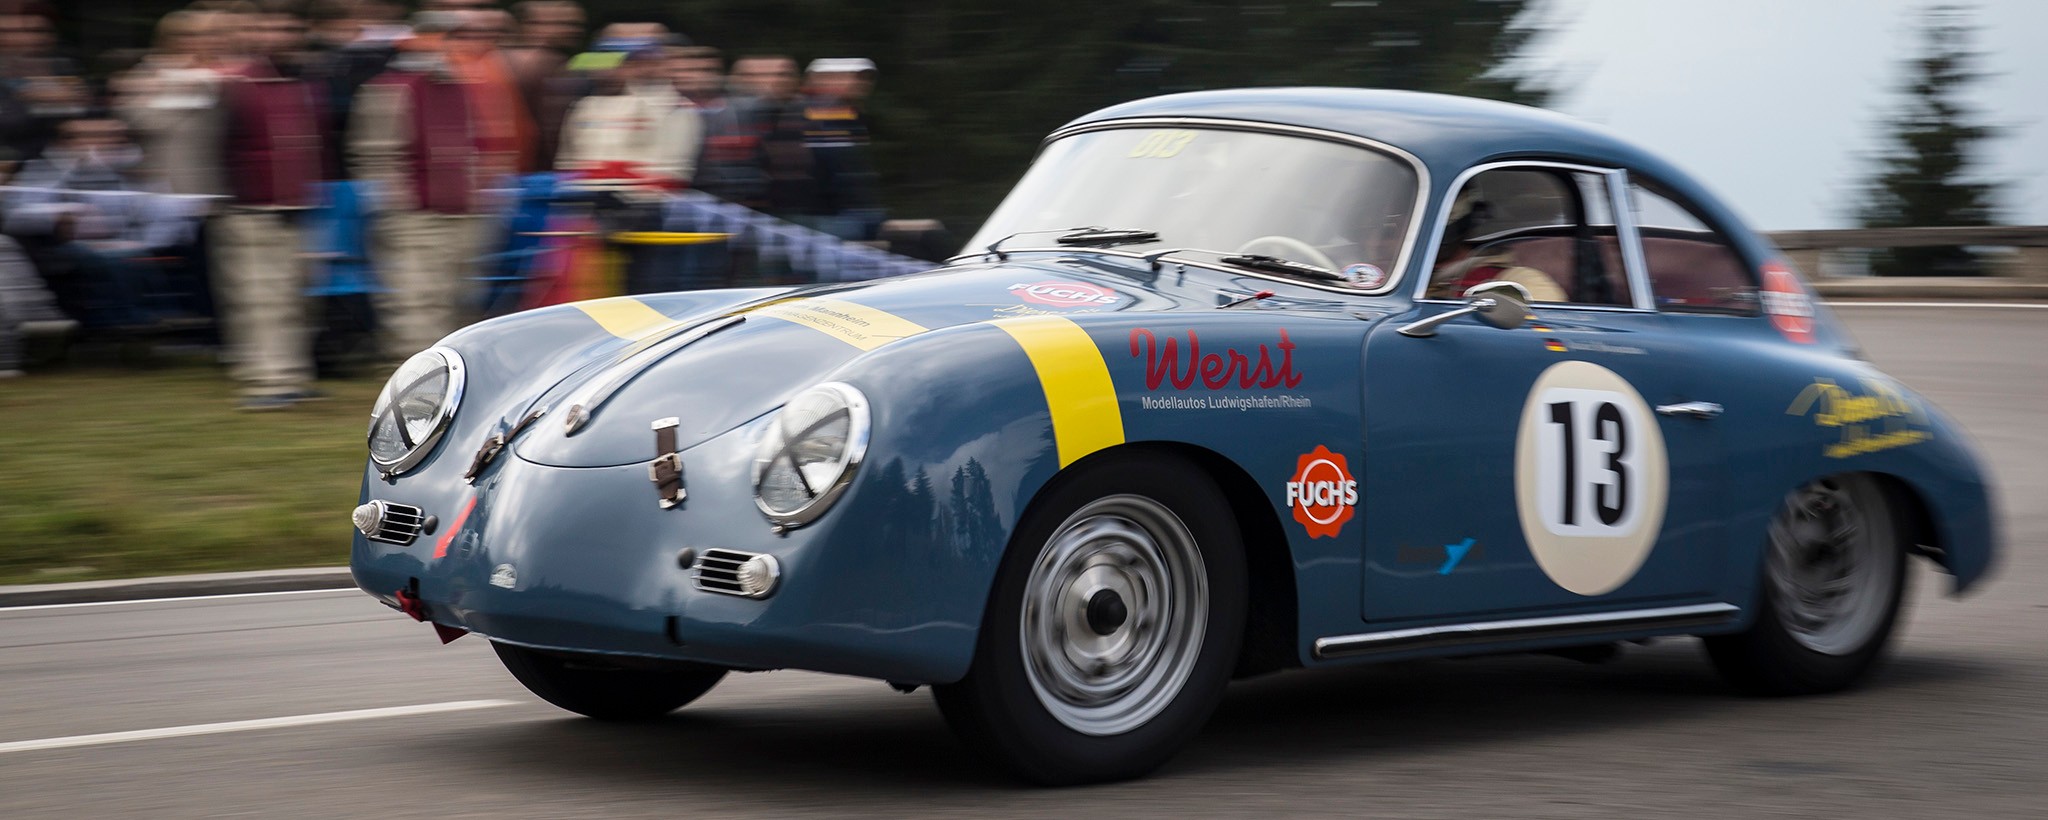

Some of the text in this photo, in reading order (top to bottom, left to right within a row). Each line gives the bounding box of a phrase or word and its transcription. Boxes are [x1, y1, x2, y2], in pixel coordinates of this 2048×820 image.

[1006, 283, 1121, 304] FUCHS
[1130, 327, 1304, 391] Werst
[1141, 395, 1312, 412] Modellautos Ludwigshafen/Rhein
[1545, 400, 1634, 527] 13
[1286, 480, 1359, 507] FUCHS
